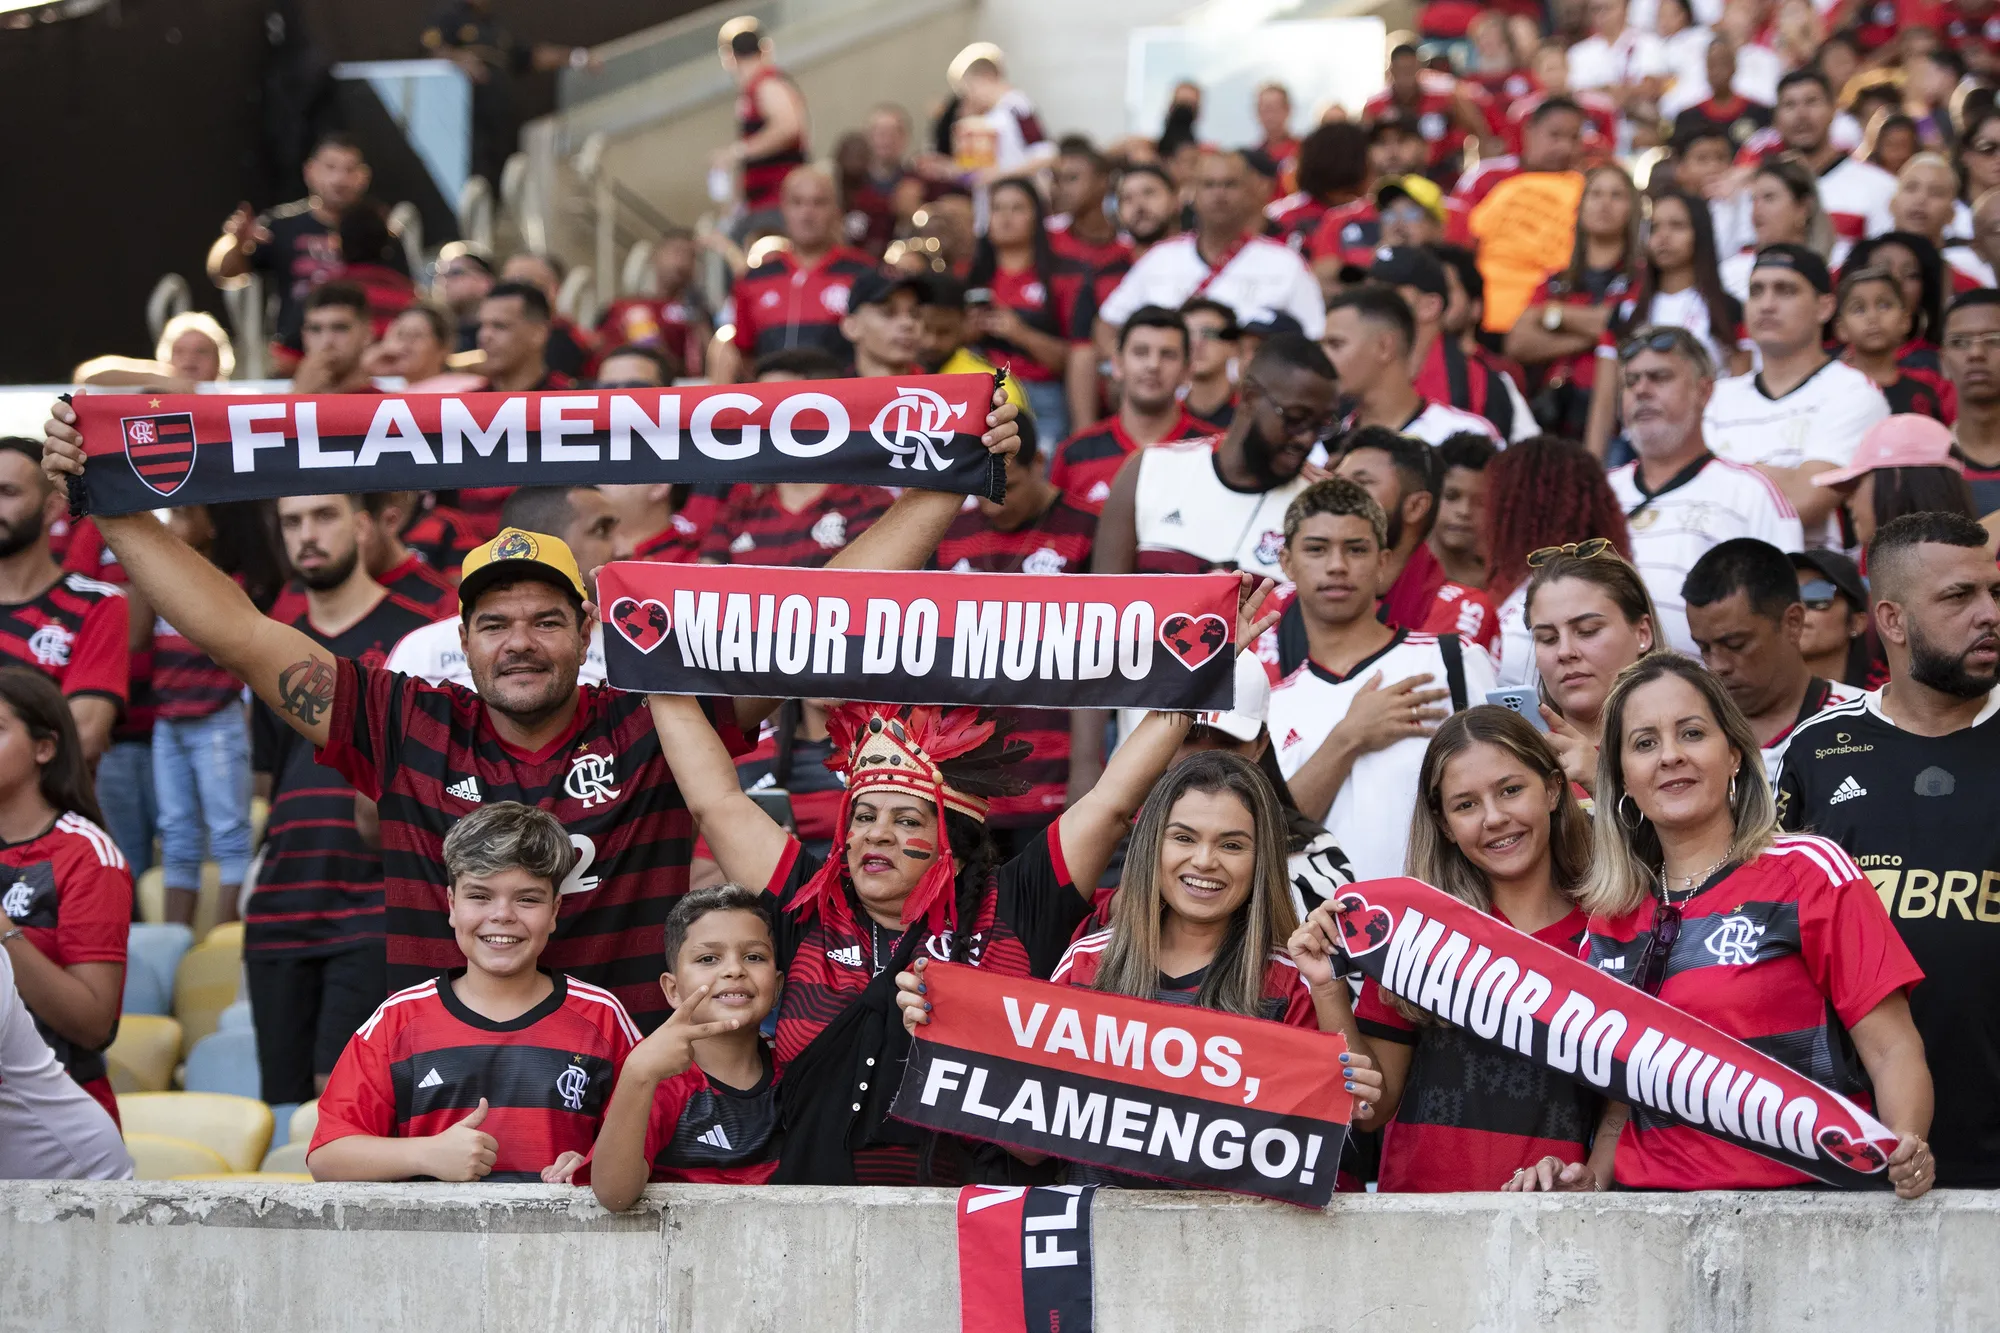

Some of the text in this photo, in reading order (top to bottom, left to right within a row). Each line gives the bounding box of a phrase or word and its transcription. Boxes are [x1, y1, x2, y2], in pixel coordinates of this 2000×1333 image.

[227, 393, 851, 473] FLAMENGO
[673, 590, 850, 675] MAIOR
[862, 598, 939, 677] DO
[951, 600, 1155, 681] MUNDO
[1815, 743, 1874, 759] Sportsbet.io
[445, 786, 482, 803] adidas
[1829, 786, 1868, 805] adidas
[826, 950, 863, 967] adidas
[1002, 996, 1261, 1105] VAMOS,
[1381, 906, 1819, 1160] MAIOR DO MUNDO
[920, 1057, 1323, 1185] FLAMENGO!
